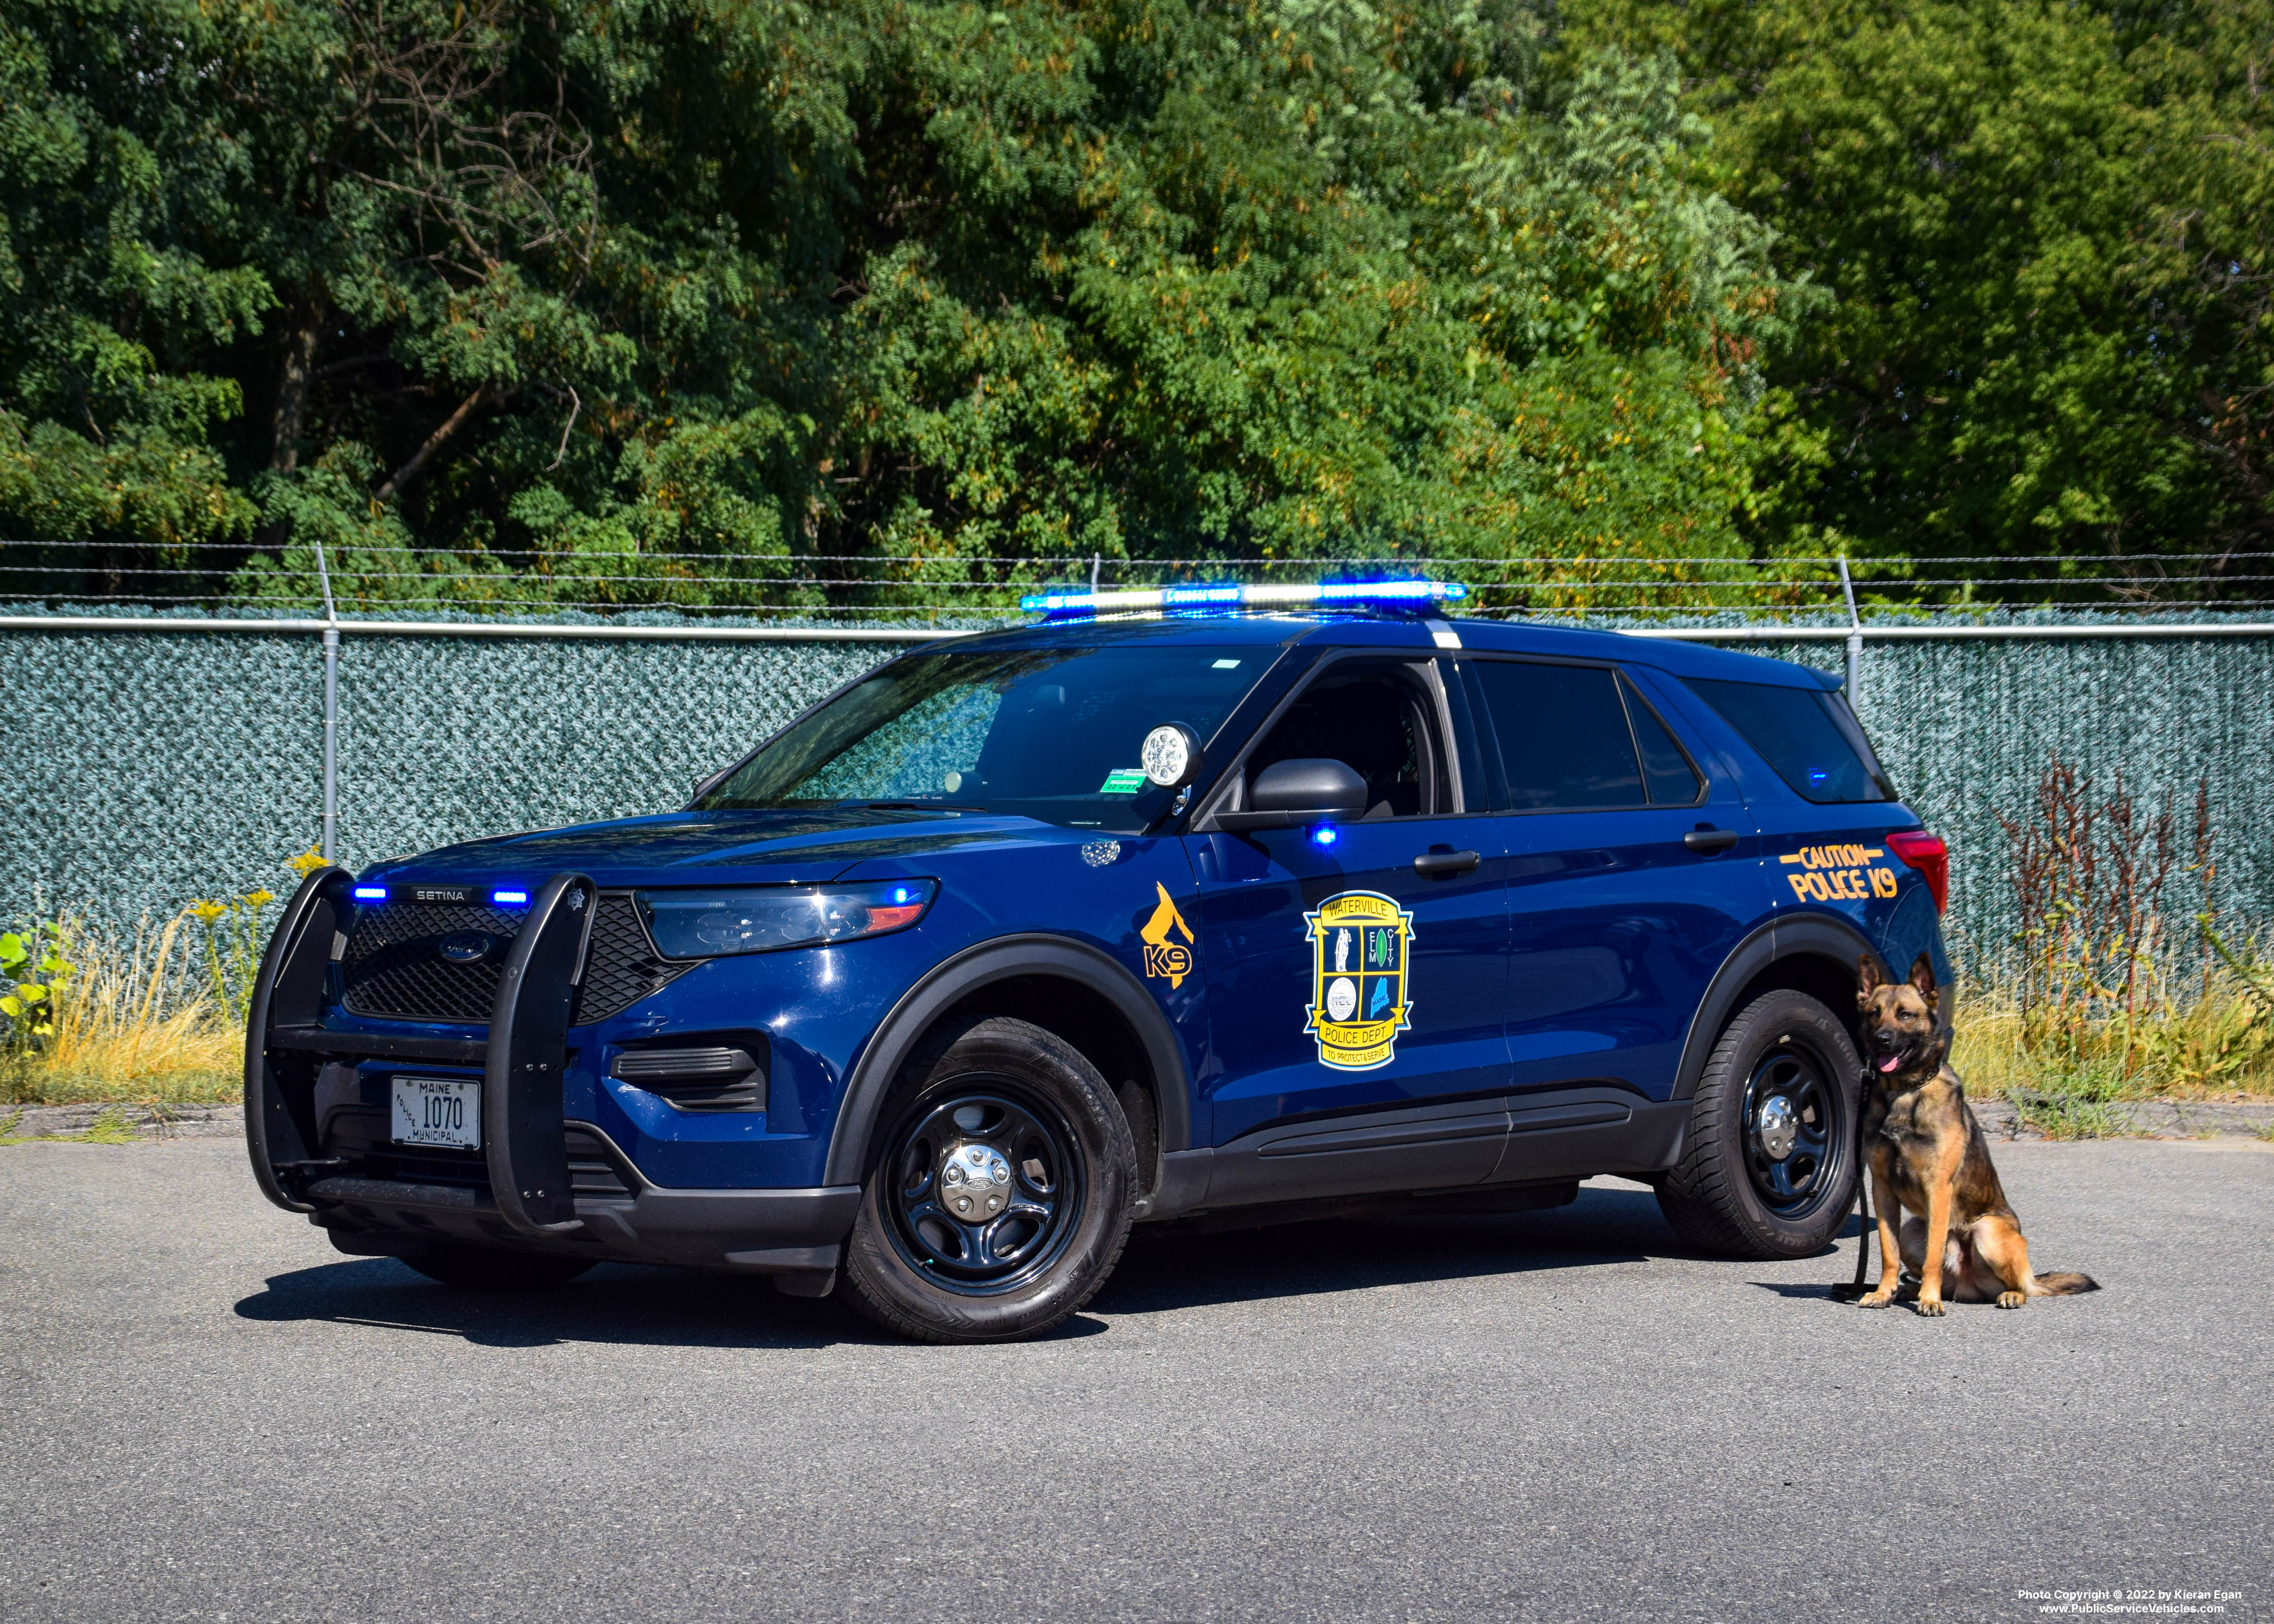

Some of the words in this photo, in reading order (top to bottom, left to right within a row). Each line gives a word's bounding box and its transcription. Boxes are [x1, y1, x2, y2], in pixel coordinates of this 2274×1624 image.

[1799, 844, 1870, 869] CAUTION
[1787, 869, 1869, 903] POLICE
[1867, 868, 1897, 898] K9
[417, 891, 465, 900] SETINA
[1329, 900, 1388, 916] WATERVILLE
[1143, 945, 1192, 977] K9
[1372, 994, 1386, 1005] MAINE
[1325, 1027, 1358, 1044] POLICE
[1362, 1026, 1388, 1043] DEPT.
[1328, 1050, 1335, 1059] TO
[419, 1083, 450, 1094] MAINE
[397, 1094, 415, 1126] POLICE
[424, 1096, 462, 1130] 1070
[413, 1130, 456, 1143] MUNICIPAL
